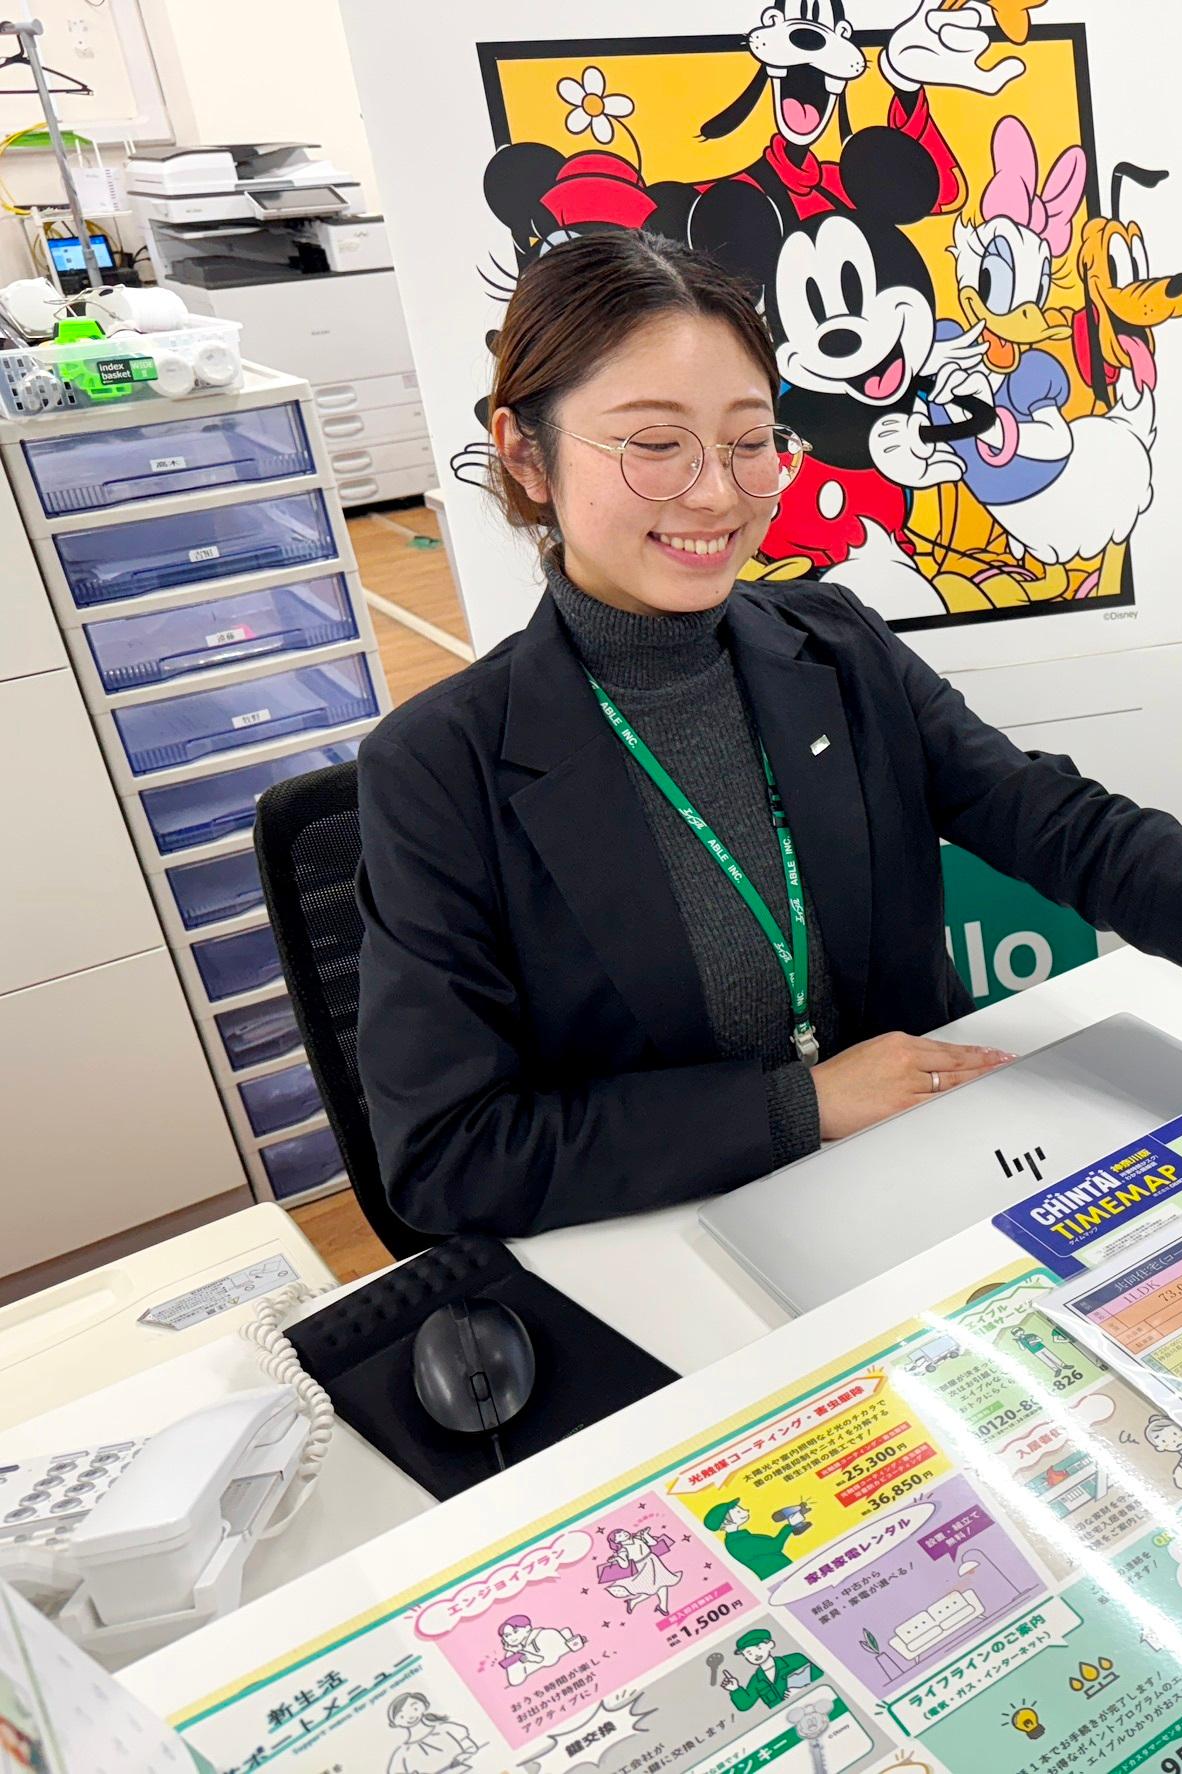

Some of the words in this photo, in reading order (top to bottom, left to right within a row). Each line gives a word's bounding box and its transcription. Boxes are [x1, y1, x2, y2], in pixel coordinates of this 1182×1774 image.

[99, 363, 125, 372] index
[101, 370, 132, 380] basket
[600, 701, 623, 727] ABLE
[621, 728, 639, 749] INC.
[707, 838, 729, 862] ABLE
[727, 864, 744, 884] INC.
[782, 835, 792, 855] INC.
[786, 860, 799, 886] ABLE
[1051, 1165, 1177, 1240] TIMEMAP
[1121, 1278, 1161, 1304] 1LDK
[962, 1303, 1009, 1330] エイブル
[685, 1384, 866, 1486] 光触媒コーティング・害虫駆除
[840, 1439, 910, 1483] 25,300円
[865, 1467, 936, 1512] 36,850円
[801, 1515, 914, 1586] 家具家電レンタル
[922, 1509, 983, 1548] 設置・組立て
[444, 1545, 568, 1617] エンジョイプラン
[809, 1568, 883, 1616] 新品・中古から
[817, 1561, 917, 1625] 家具・家電が選べる！
[508, 1645, 619, 1714] おうち時間が楽しく、
[905, 1612, 1047, 1709] ライフラインのご案内
[267, 1669, 346, 1729] 新生活
[514, 1671, 598, 1724] お出かけ時間が
[520, 1682, 603, 1735] アクティブに！
[562, 1719, 619, 1758] 鍵交換
[613, 1742, 667, 1774] 工会社が
